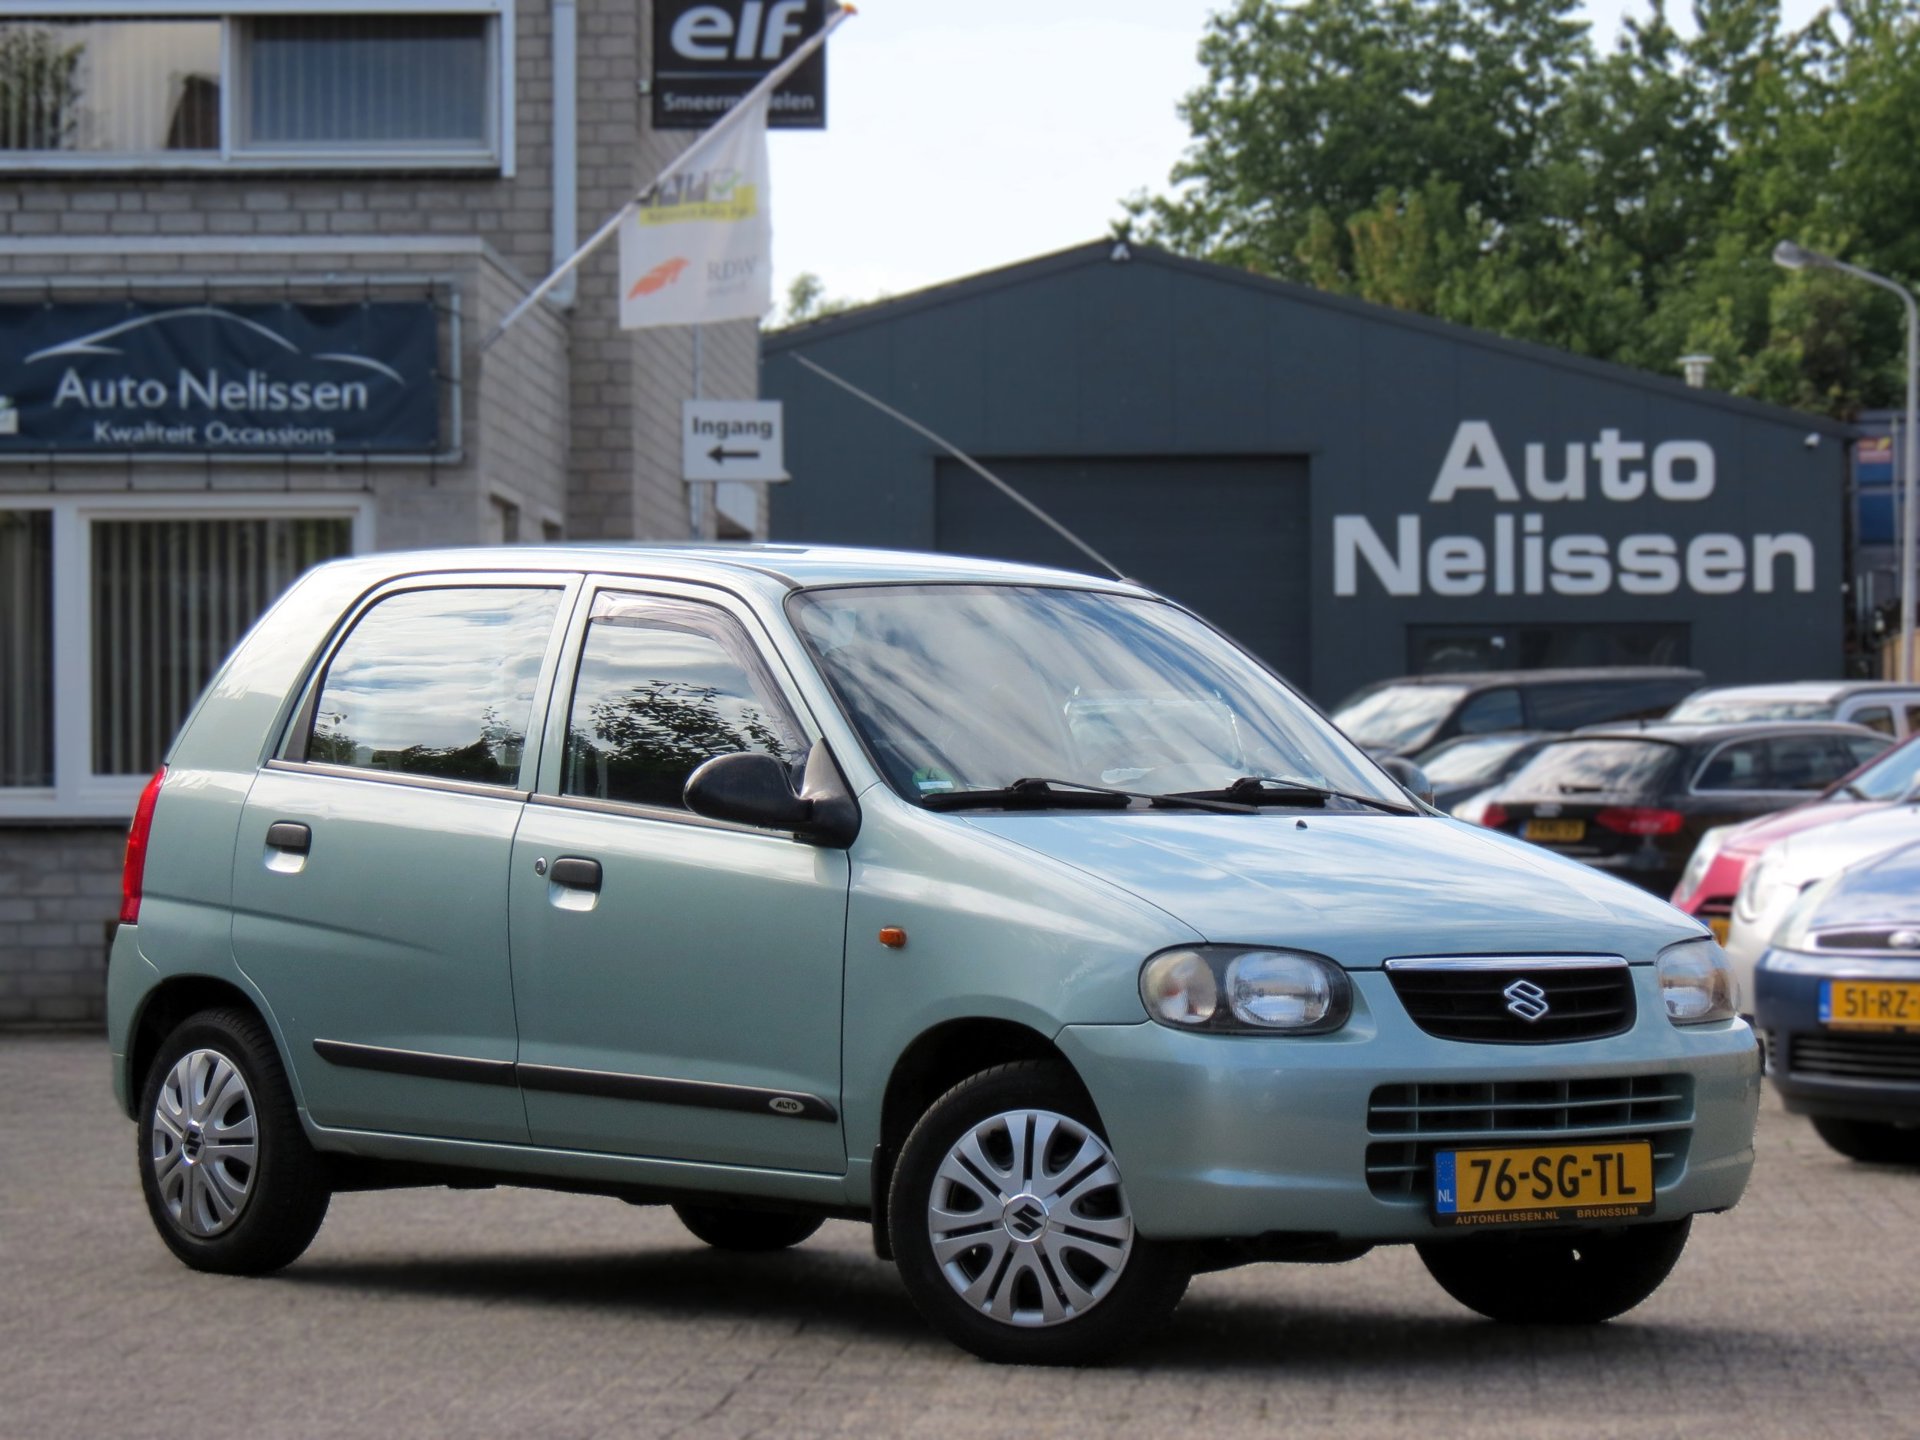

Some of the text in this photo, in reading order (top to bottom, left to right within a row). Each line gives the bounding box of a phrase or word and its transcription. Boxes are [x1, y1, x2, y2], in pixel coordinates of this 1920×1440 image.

[671, 0, 806, 60] elf
[663, 91, 816, 111] Smeermelen
[53, 368, 368, 411] Auto Nelissen
[93, 421, 336, 445] Kwaliteit Occassions
[692, 416, 773, 441] Ingang
[1428, 420, 1716, 502] Auto
[1333, 513, 1815, 597] Nelissen
[1844, 987, 1920, 1019] 51-RZ-
[776, 1101, 798, 1111] ALTO
[1438, 1152, 1636, 1203] NL 76-SG-TL
[1456, 1206, 1639, 1225] AUTONELISSEN.NL BRUNSSUM
